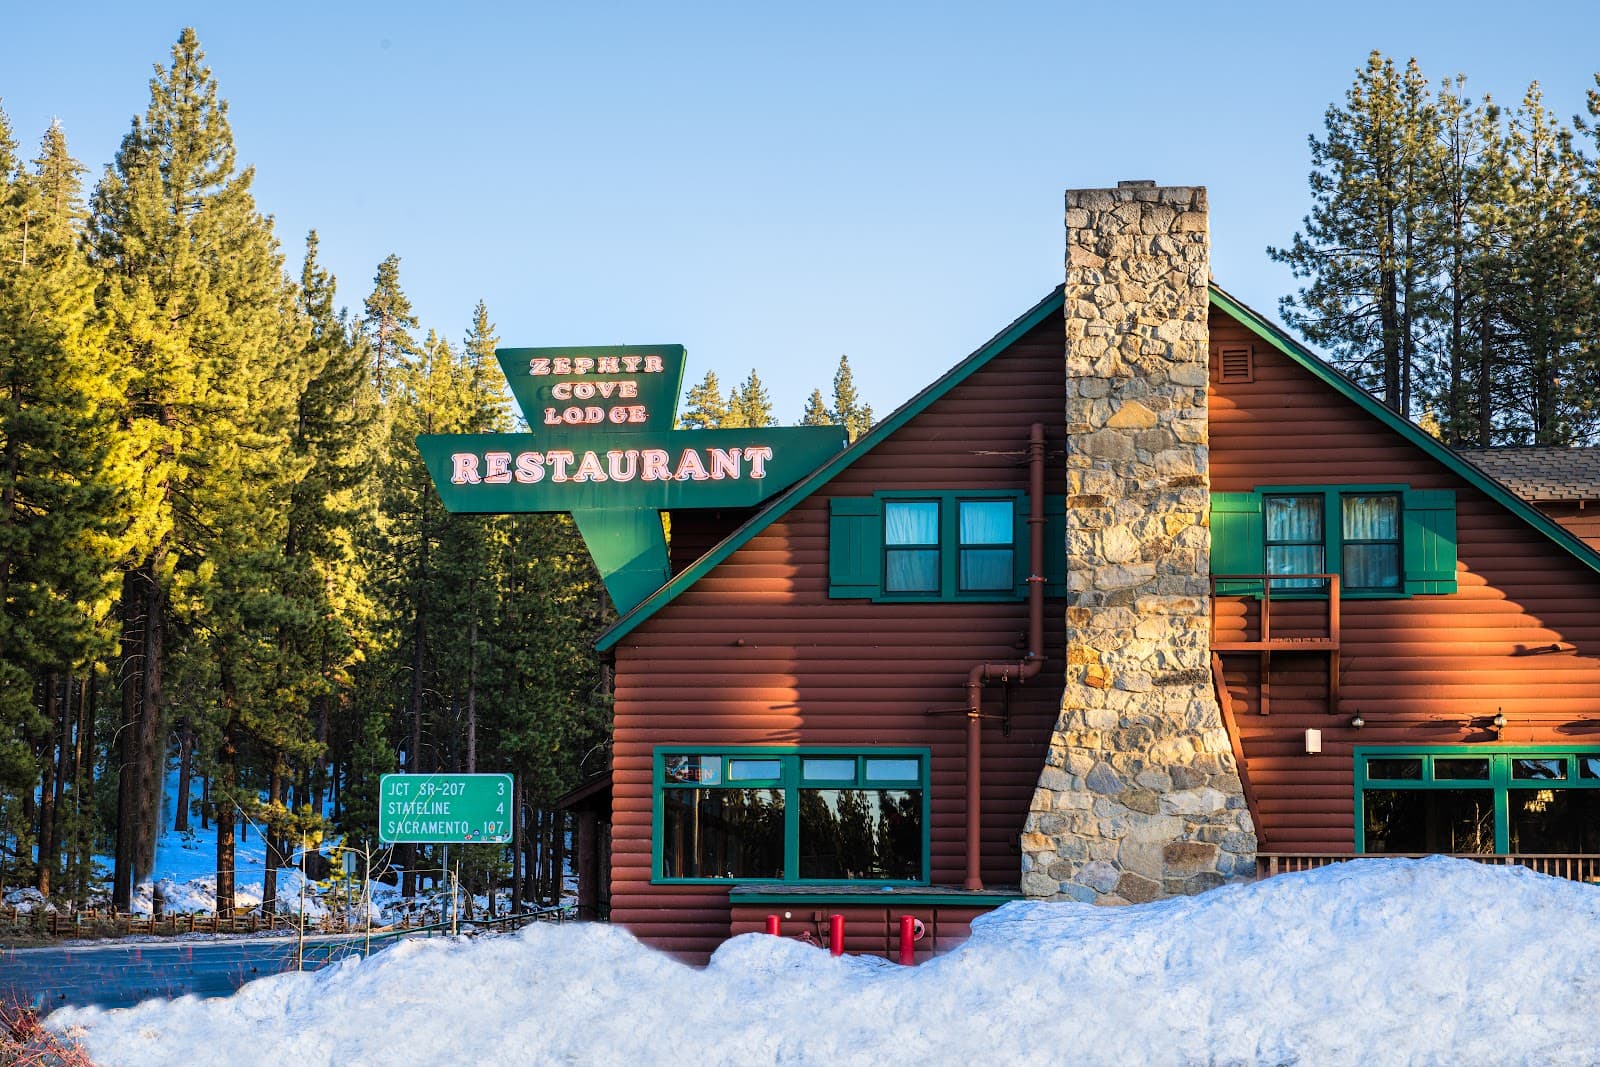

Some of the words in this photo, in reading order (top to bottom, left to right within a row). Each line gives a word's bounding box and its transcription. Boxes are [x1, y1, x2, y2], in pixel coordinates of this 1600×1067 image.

[529, 355, 665, 376] ZEPHYR
[551, 380, 638, 401] COVE
[544, 404, 649, 425] LODGE
[451, 446, 773, 485] RESTAURANT
[388, 782, 410, 795] JCT
[420, 782, 466, 795] SR-207
[497, 782, 505, 795] 3
[388, 802, 451, 815] STATELINE
[496, 802, 504, 815] 4
[388, 821, 469, 834] SACRAMENTO
[483, 821, 504, 834] 107
